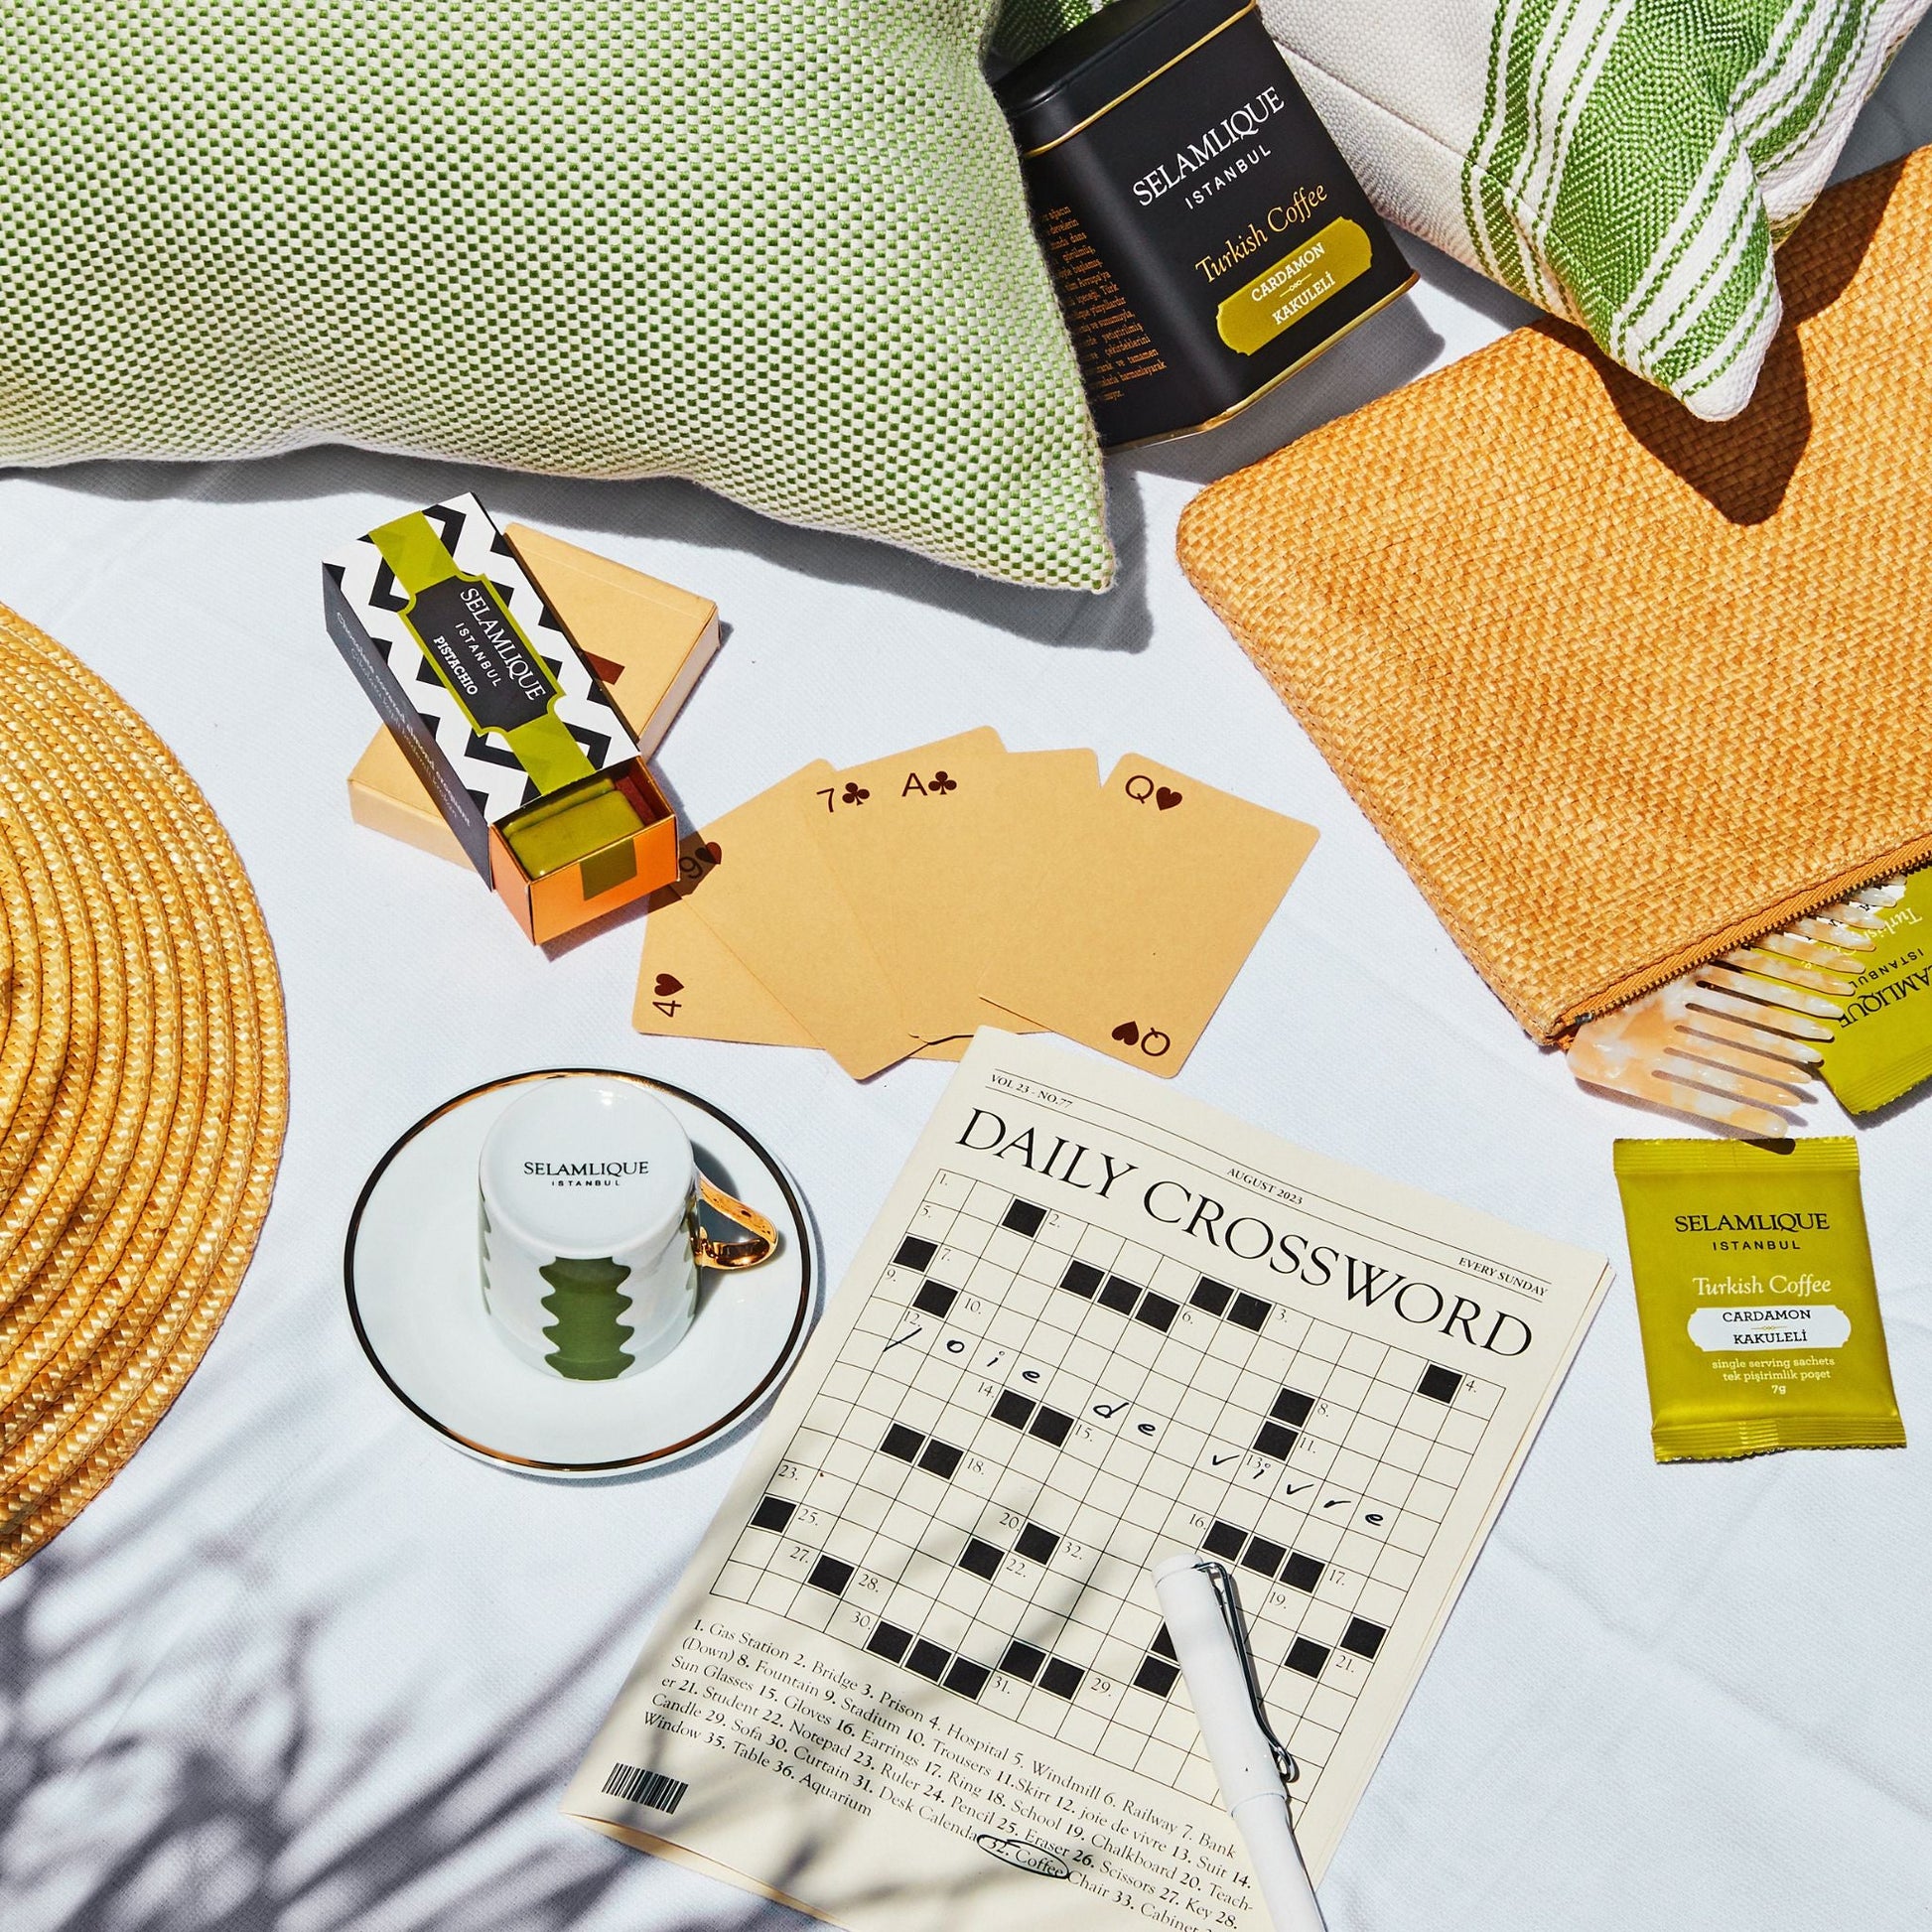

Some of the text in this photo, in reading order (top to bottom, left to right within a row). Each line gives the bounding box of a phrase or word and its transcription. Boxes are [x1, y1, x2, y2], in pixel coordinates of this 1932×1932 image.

[1132, 86, 1285, 207] SELAMLIQUE
[1185, 144, 1272, 209] ISTANBUL
[1195, 183, 1328, 283] Turkish Coffee
[1251, 242, 1325, 302] CARDAMON
[1273, 273, 1337, 326] KAKULELİ
[460, 587, 546, 702] SELAMLIQUE
[456, 622, 502, 687] ISTANBUL
[433, 635, 478, 696] PISTACHIO
[901, 772, 927, 798] A
[1125, 774, 1153, 804] Q
[816, 787, 837, 813] 7
[1849, 948, 1924, 988] ISTANBUL
[652, 1000, 682, 1018] 4
[1140, 1027, 1171, 1057] Q
[991, 1073, 1014, 1088] VOL
[1016, 1083, 1030, 1093] 23
[523, 1161, 649, 1176] SELAMLIQUE
[939, 1173, 948, 1185] 1.
[1227, 1168, 1304, 1206] AUGUST 2023
[920, 1205, 931, 1218] 5.
[1048, 1214, 1060, 1228] 2.
[955, 1107, 1533, 1357] DAILY CROSSWORD
[1675, 1213, 1830, 1233] SELAMLIQUE
[941, 1248, 951, 1262] 7.
[1713, 1240, 1801, 1252] ISTANBUL
[887, 1269, 897, 1282] 9.
[1458, 1257, 1549, 1299] EVERY SUNDAY
[1693, 1275, 1832, 1297] Turkish Coffee
[964, 1297, 982, 1315] 10.
[1276, 1308, 1288, 1323] 3.
[903, 1311, 920, 1327] 12.
[1181, 1311, 1193, 1325] 6.
[1723, 1310, 1812, 1323] CARDAMON
[1733, 1330, 1808, 1345] KAKULELİ
[1712, 1355, 1836, 1369] single serving sachets
[1723, 1369, 1831, 1382] tek pişirimlik poşet
[977, 1381, 995, 1399] 14.
[1465, 1378, 1477, 1394] 4.
[1771, 1384, 1787, 1395] 7g
[1317, 1403, 1329, 1418] 8.
[1075, 1424, 1093, 1443] 15.
[1300, 1437, 1316, 1454] 11.
[778, 1464, 798, 1482] 23.
[967, 1456, 985, 1475] 18.
[797, 1508, 819, 1527] 25.
[999, 1512, 1021, 1532] 20.
[1188, 1513, 1207, 1531] 16.
[789, 1546, 810, 1565] 27.
[1061, 1542, 1083, 1561] 32.
[1006, 1559, 1028, 1578] 22.
[1328, 1569, 1346, 1587] 17.
[858, 1575, 880, 1592] 28.
[1269, 1591, 1287, 1609] 19.
[849, 1610, 872, 1630] 30.
[1335, 1655, 1355, 1673] 21.
[992, 1677, 1011, 1695] 31.
[1090, 1678, 1113, 1698] 29.
[693, 1618, 1236, 1860] 1. Gas Station 2. Bridge 3. Prison 4. Hospital 5. Windmill 6. Railway 7. Bank
[644, 1711, 872, 1817] Window 35. Table 36. Aquarium
[682, 1636, 736, 1664] (Down)
[736, 1653, 751, 1669] 8.
[755, 1659, 819, 1698] Fountain
[823, 1689, 836, 1705] 9.
[840, 1697, 901, 1735] Stadium
[905, 1727, 925, 1747] 10.
[932, 1737, 992, 1777] Trousers
[1055, 1796, 1075, 1814] 12.
[1076, 1806, 1108, 1827] joie
[1110, 1819, 1130, 1836] de
[1133, 1830, 1168, 1853] vivre
[1171, 1845, 1192, 1864] 13.
[1195, 1856, 1228, 1878] Suit
[1231, 1871, 1251, 1889] 14.
[670, 1654, 1253, 1911] Sun Glasses 15. Gloves 16. Earrings 17. Ring 18. School 19. Chalkboard 20. Teach-
[651, 1693, 702, 1718] Candle
[704, 1709, 727, 1727] 29.
[730, 1719, 762, 1742] Sofa
[764, 1733, 788, 1753] 30.
[793, 1745, 850, 1782] Curtain
[851, 1774, 874, 1794] 31.
[878, 1785, 914, 1813] Desk
[918, 1805, 979, 1843] Calenda
[1016, 1849, 1063, 1876] Coffee
[1067, 1870, 1110, 1897] Chair
[1111, 1889, 1135, 1910] 33.
[1141, 1902, 1199, 1932] Cabinet
[661, 1677, 1238, 1930] er 21. Student 22. Notepad 23. Ruler 24. Pencil 25. Eraser 26. Scissors 27. Key 28.
